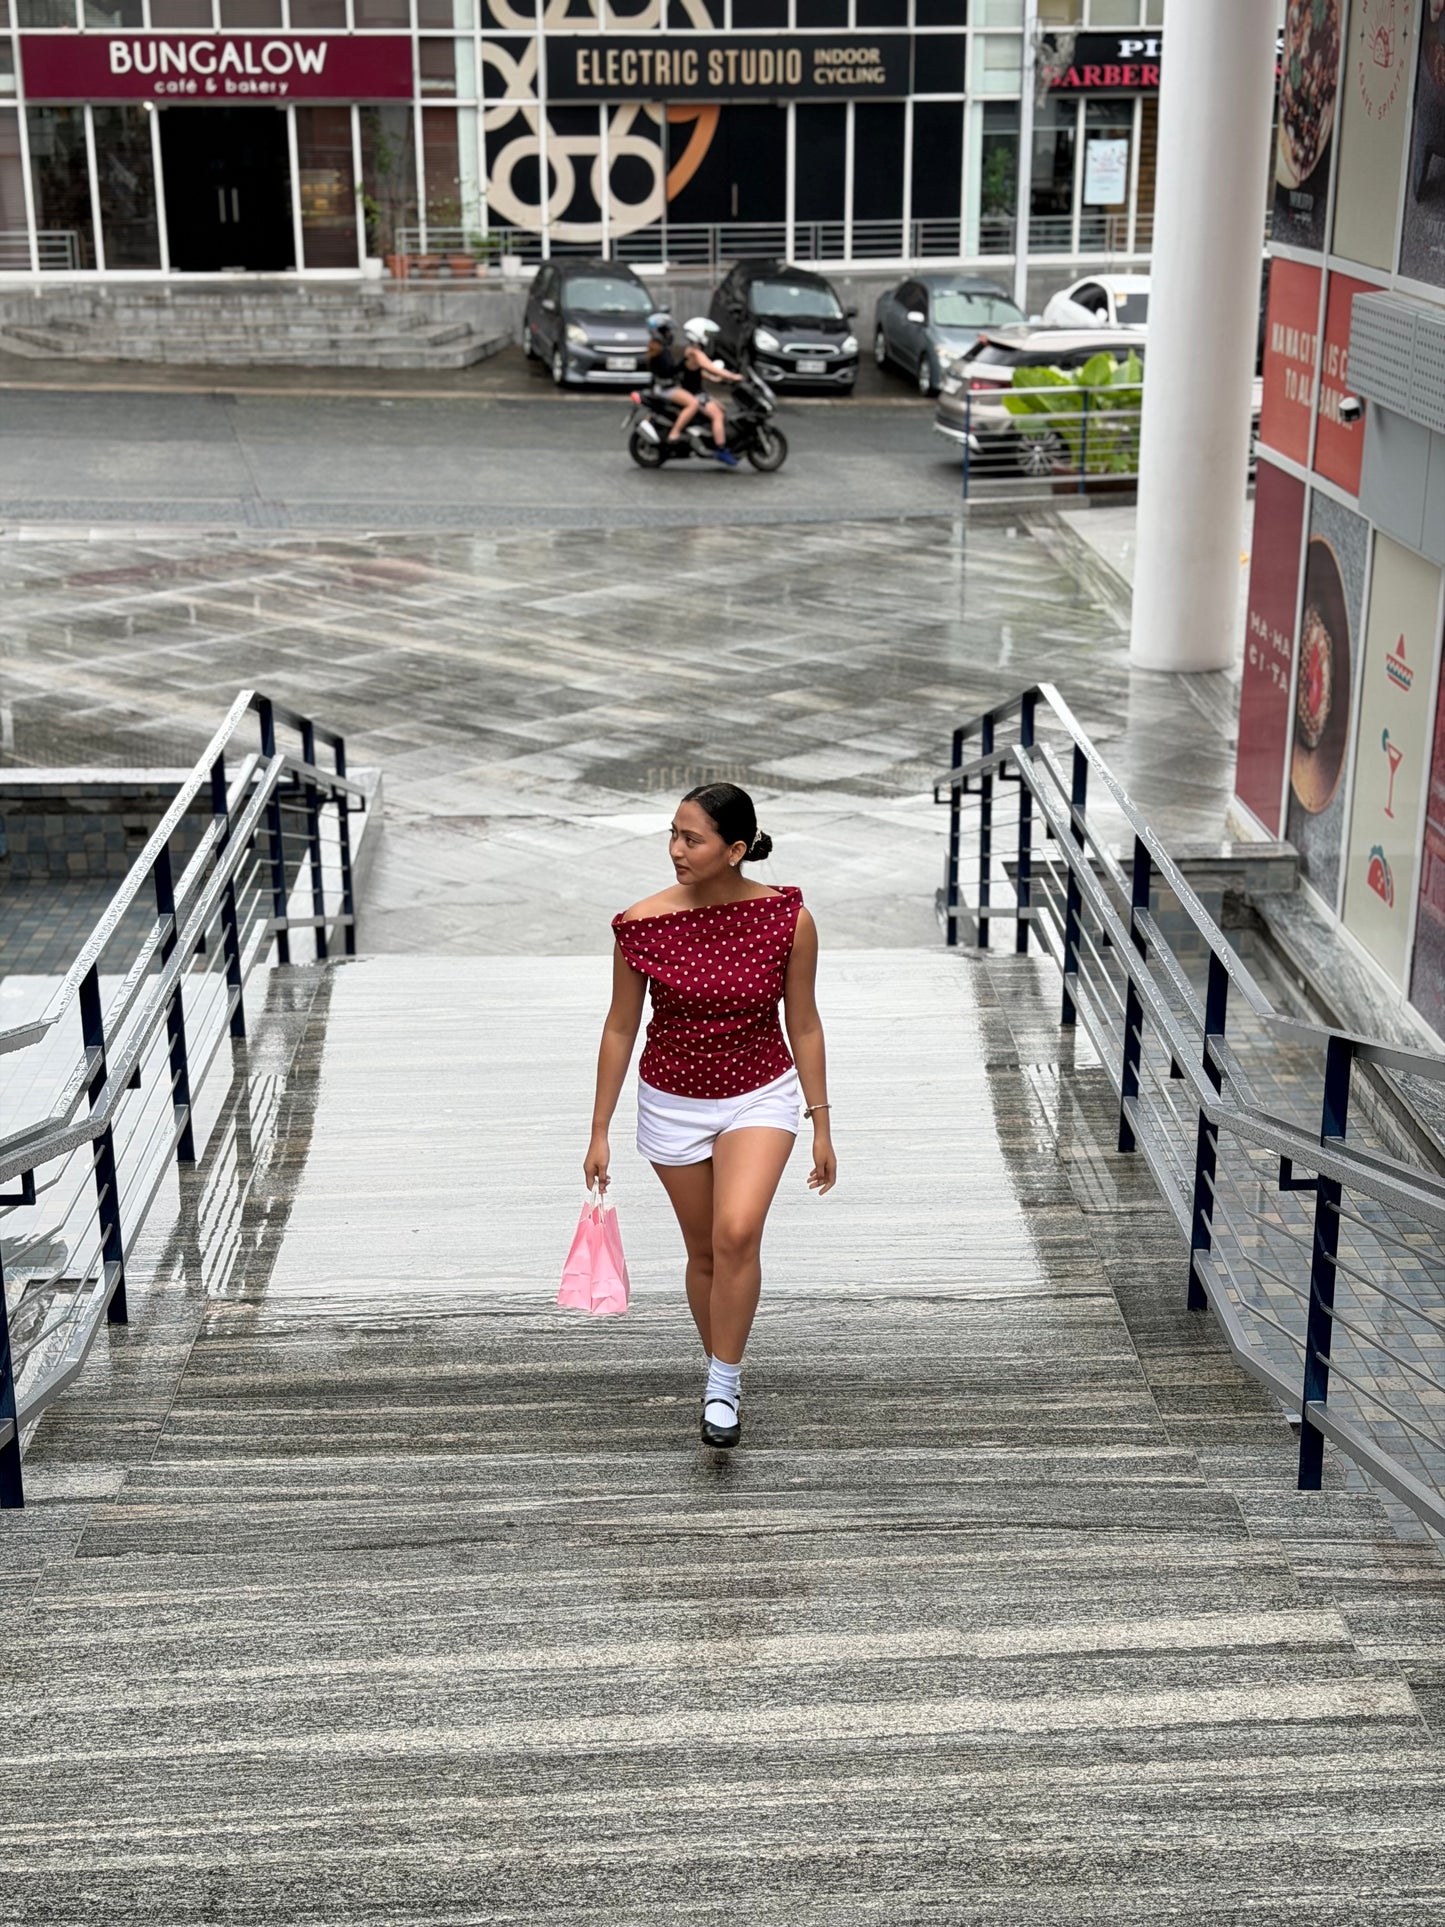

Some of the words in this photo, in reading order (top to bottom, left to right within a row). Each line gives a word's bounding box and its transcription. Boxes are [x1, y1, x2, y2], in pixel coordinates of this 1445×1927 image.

[108, 40, 328, 75] BUNGALOW
[576, 48, 699, 86] ELECTRIC
[707, 48, 802, 86] STUDIO
[813, 47, 881, 65] INDOOR
[153, 77, 198, 94] café
[205, 77, 218, 94] &
[225, 77, 289, 96] bakery
[813, 67, 886, 85] CYCLING
[1285, 367, 1298, 401] TO
